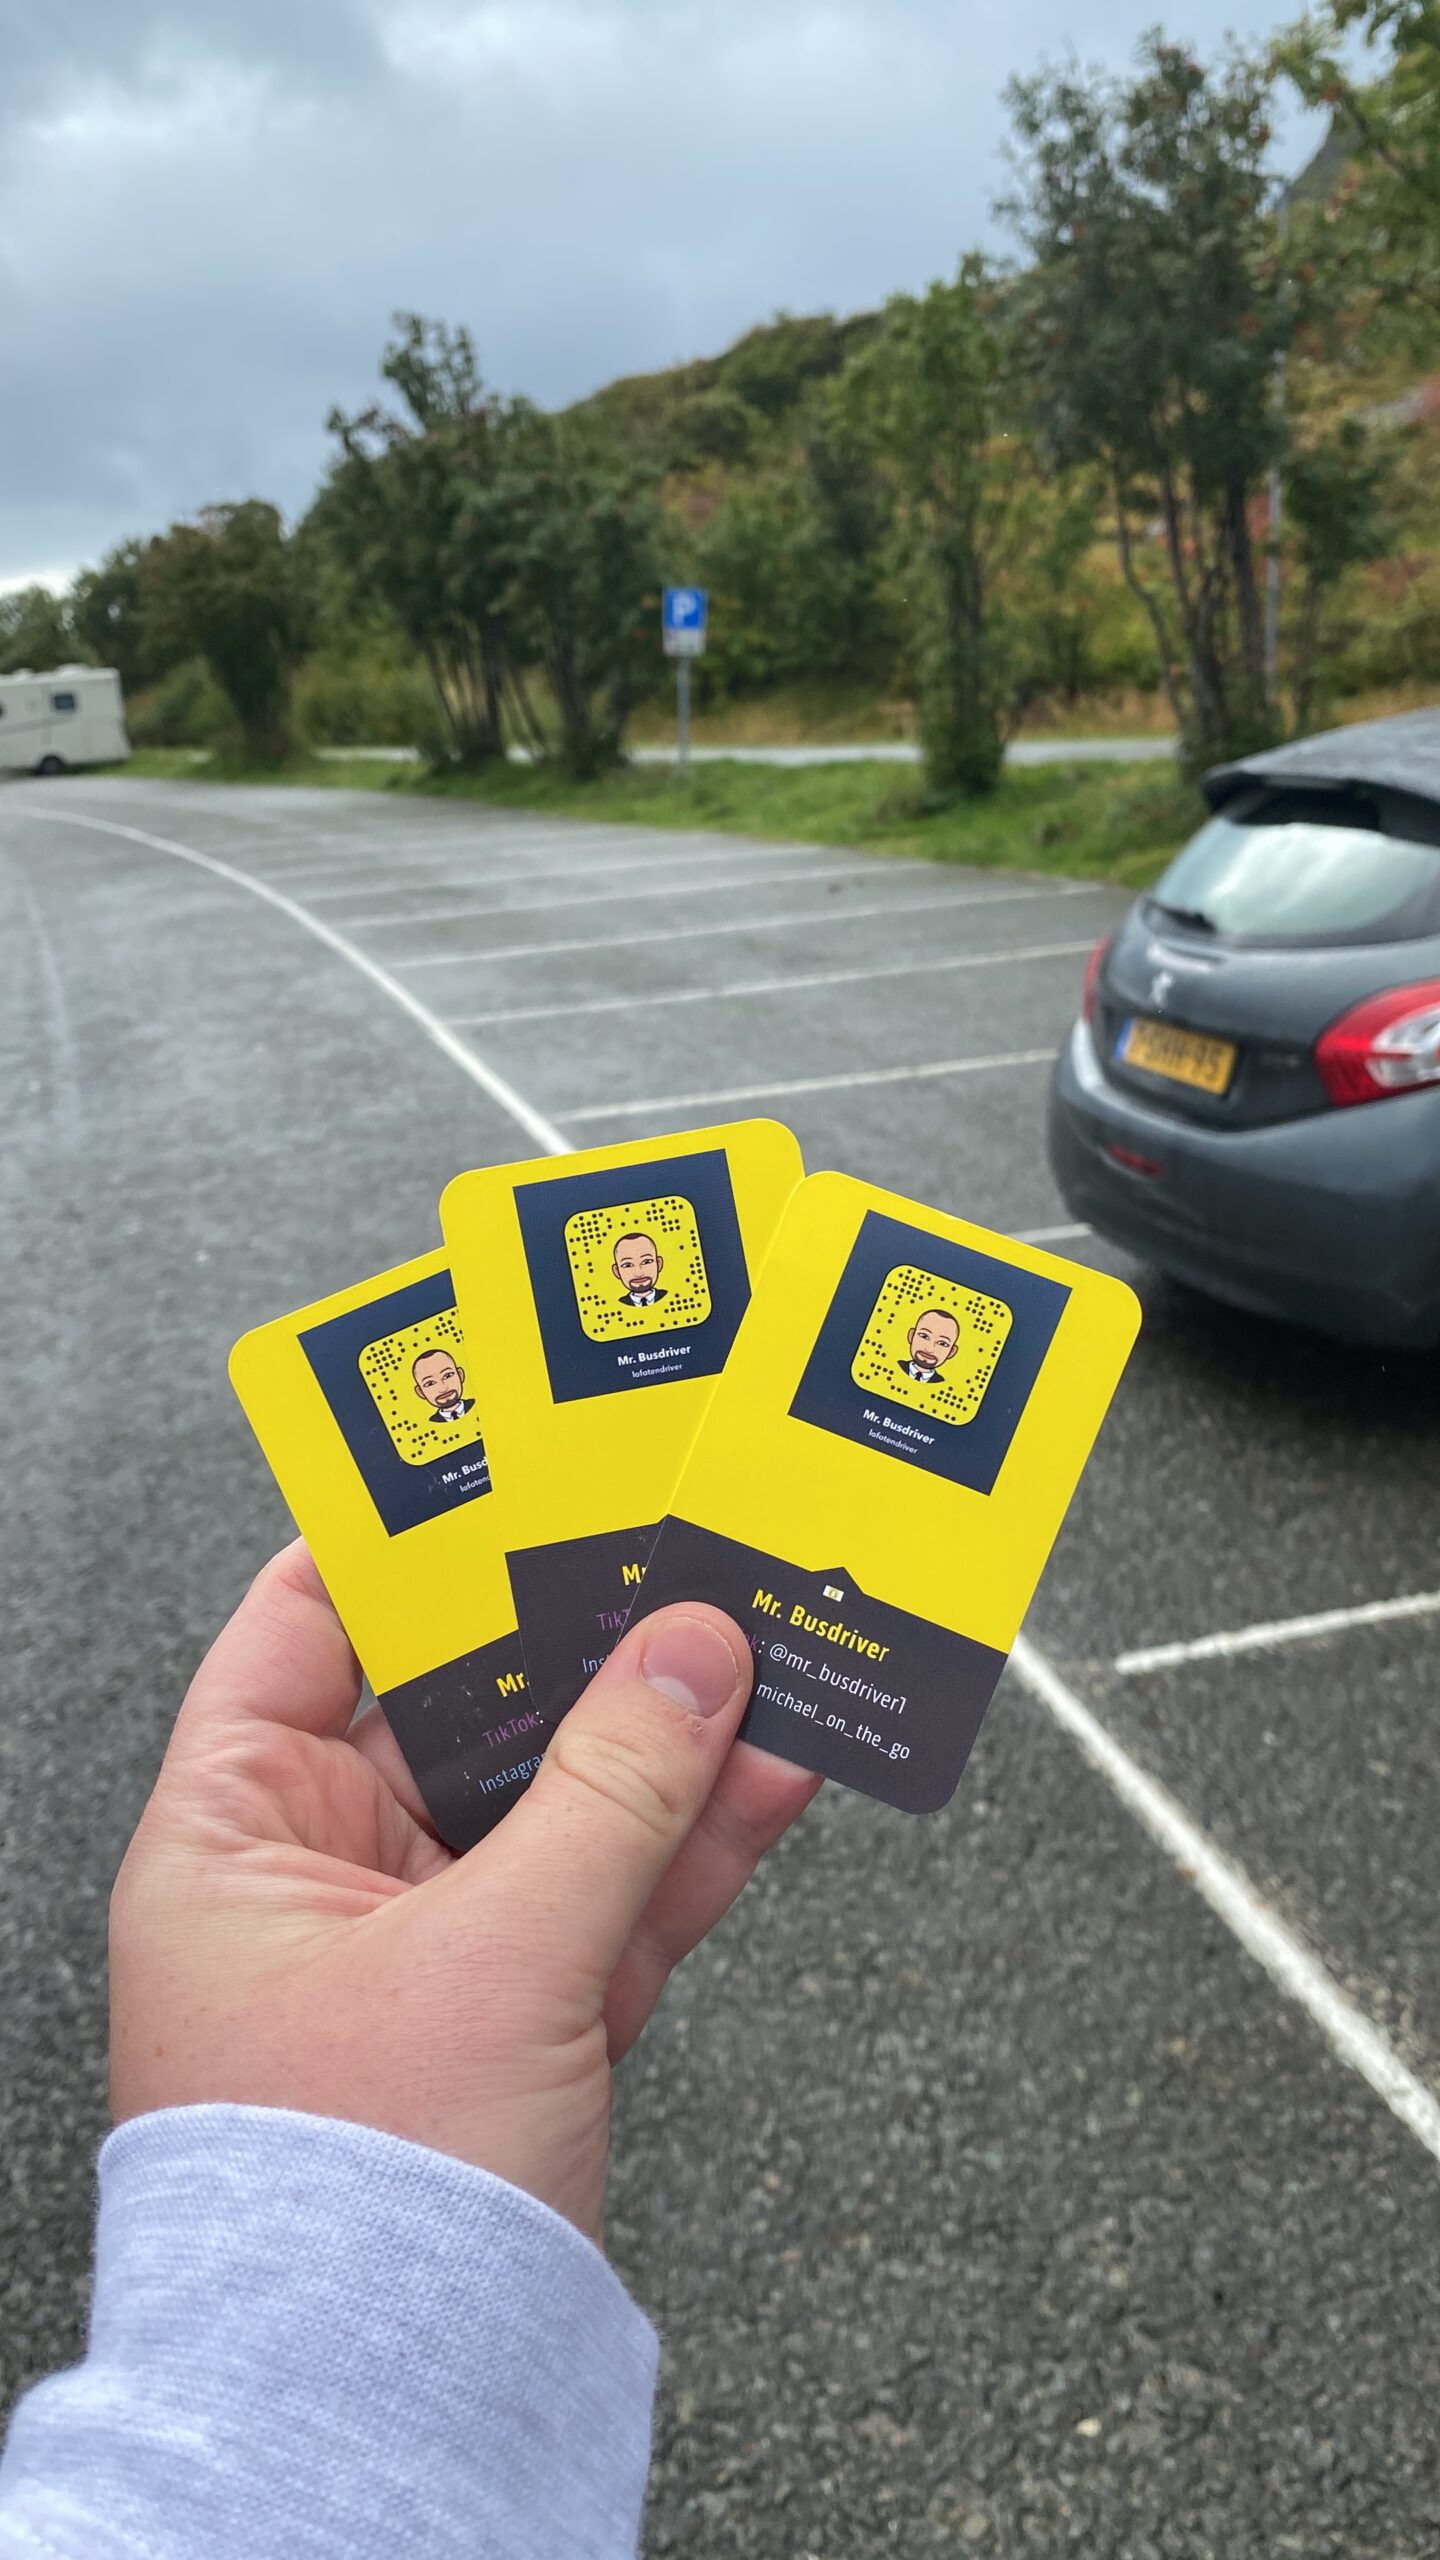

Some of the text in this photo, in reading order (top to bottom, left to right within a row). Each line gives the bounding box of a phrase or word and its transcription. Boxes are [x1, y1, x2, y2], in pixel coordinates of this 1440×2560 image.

[673, 593, 697, 626] P
[617, 1346, 691, 1366] Mr. Busdriver
[632, 1364, 683, 1378] lofotendriver
[863, 1409, 935, 1445] Mr. Busdriver
[868, 1429, 918, 1454] lofotendriver
[442, 1472, 461, 1484] Mr.
[752, 1589, 890, 1662] Mr. Busdriver
[482, 1711, 544, 1747] TikTok:
[756, 1683, 910, 1760] michael_on_the_go
[479, 1752, 545, 1794] Instagra
